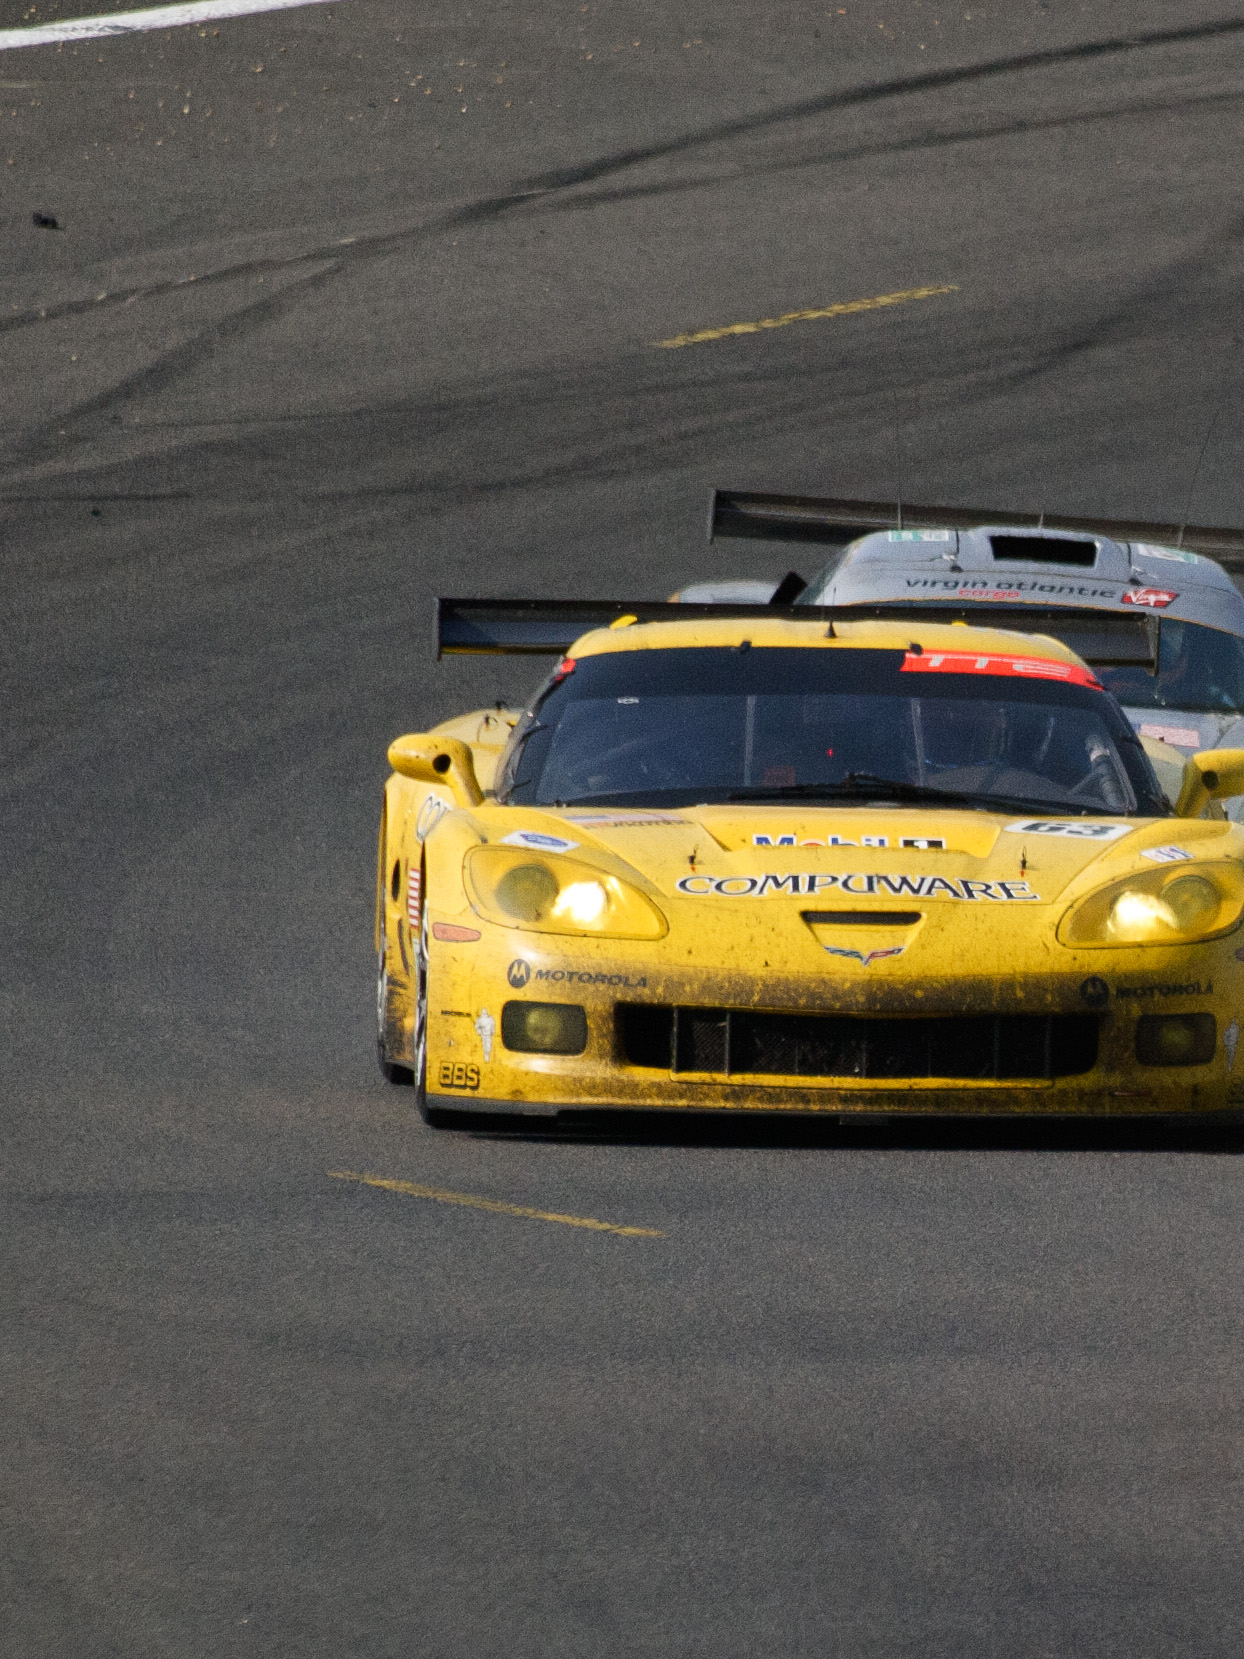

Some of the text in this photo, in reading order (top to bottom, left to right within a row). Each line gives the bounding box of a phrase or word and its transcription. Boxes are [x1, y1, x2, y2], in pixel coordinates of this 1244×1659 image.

[905, 579, 1116, 598] virgin atlantic
[1022, 822, 1116, 837] 63
[677, 872, 1040, 902] COMPUWARE
[534, 968, 648, 988] MOTOROLA
[1115, 979, 1214, 999] MOTOROLA
[440, 1062, 481, 1091] BBS
